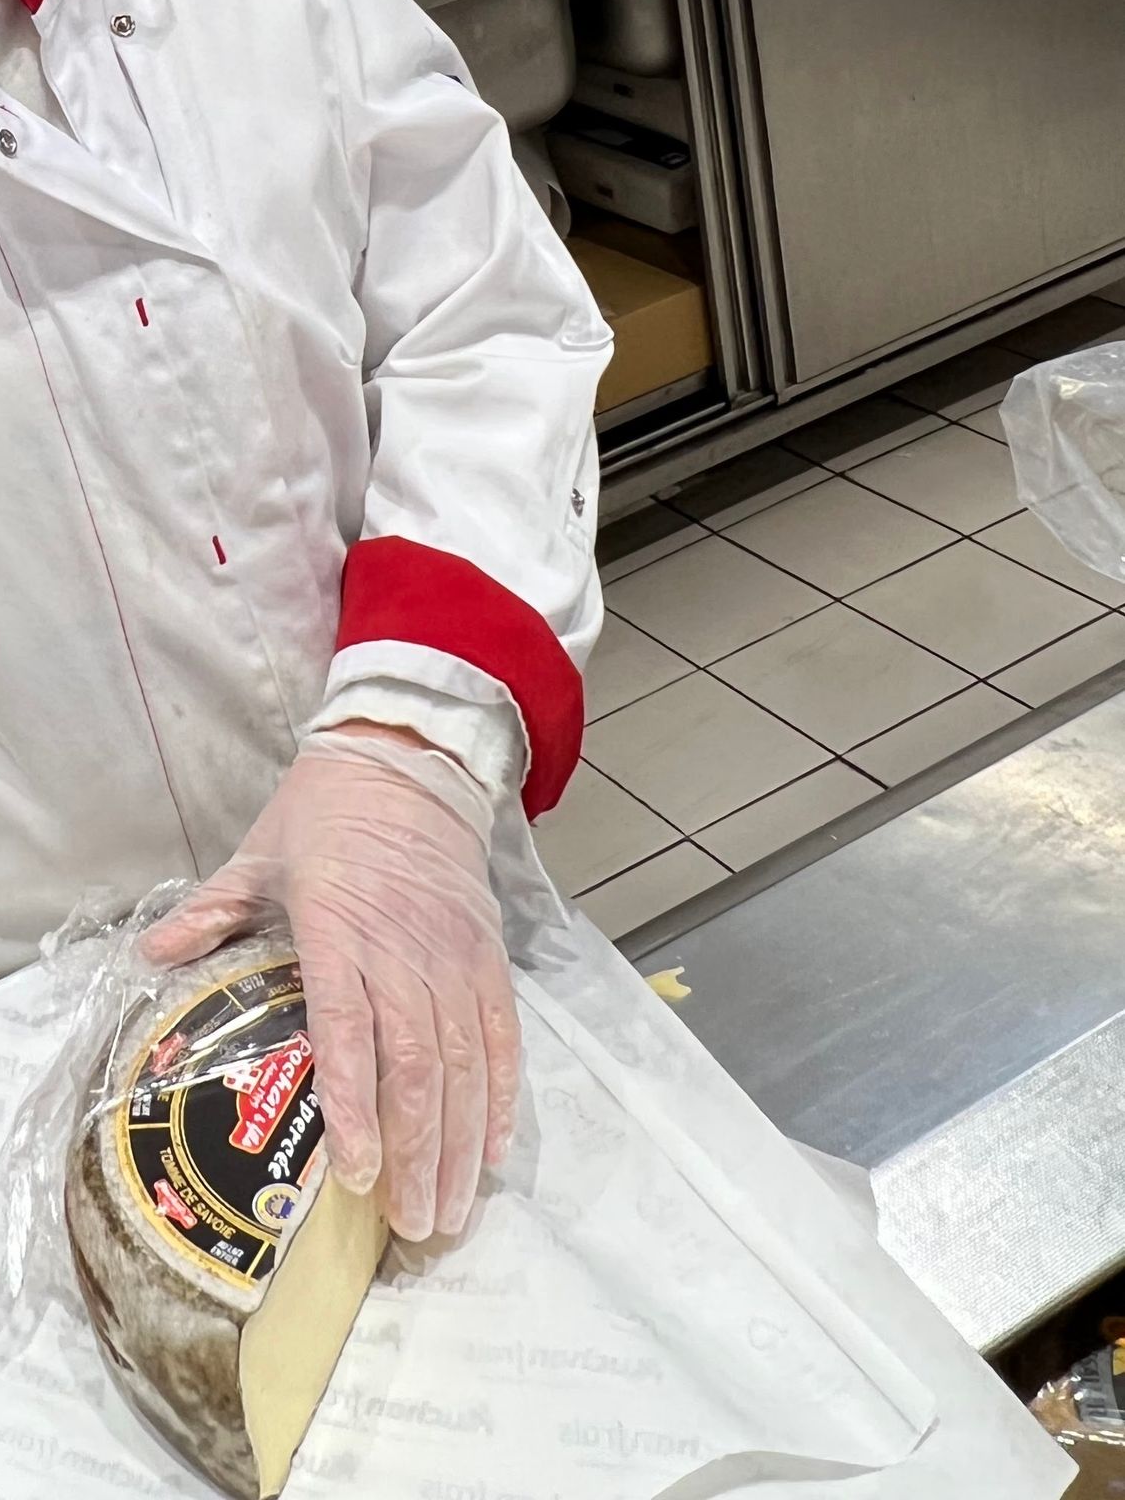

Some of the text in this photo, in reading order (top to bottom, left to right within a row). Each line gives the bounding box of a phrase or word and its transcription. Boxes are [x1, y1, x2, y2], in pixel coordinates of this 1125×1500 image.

[261, 1031, 313, 1119] Pochat
[159, 1146, 187, 1190] TOMME
[178, 1186, 198, 1206] DE
[192, 1203, 237, 1241] SAVOIE
